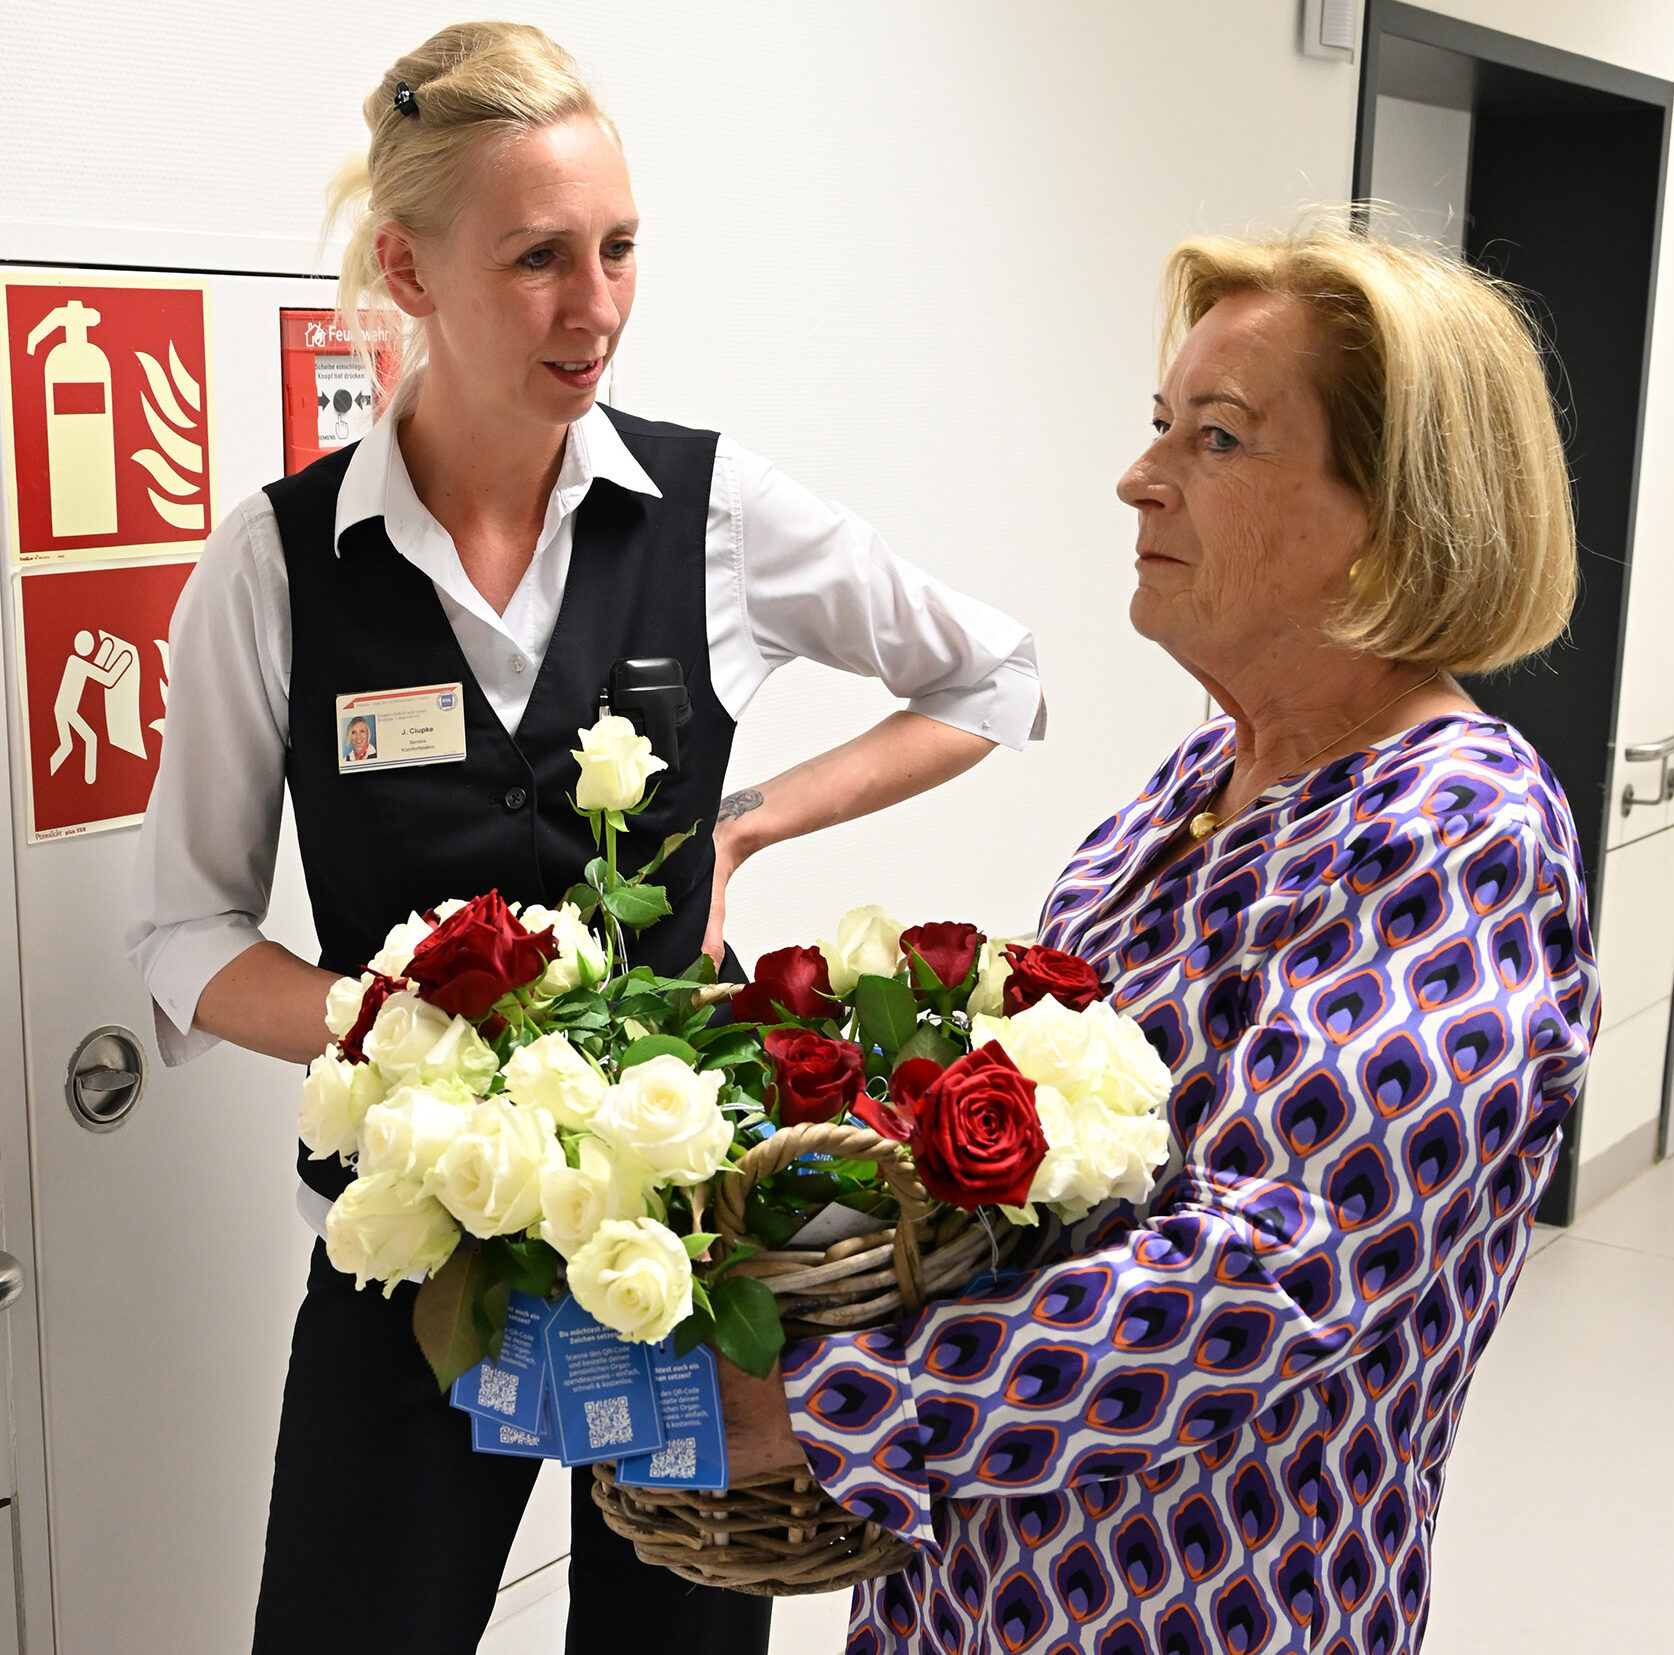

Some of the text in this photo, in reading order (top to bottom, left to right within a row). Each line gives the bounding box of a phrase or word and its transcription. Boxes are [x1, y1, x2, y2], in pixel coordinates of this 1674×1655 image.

[329, 325, 389, 341] Feuwehr
[409, 726, 434, 735] Ciupke
[570, 1326, 600, 1336] möchtest
[569, 1332, 619, 1344] Zeichen setzen
[565, 1352, 588, 1360] Scanne
[602, 1346, 630, 1356] QR-Code
[568, 1354, 630, 1369] und bestelle deinen
[569, 1365, 610, 1377] persönlichen
[673, 1363, 688, 1372] auch
[667, 1371, 692, 1380] setzen?
[572, 1383, 595, 1393] schnell
[673, 1388, 700, 1396] QR-Code
